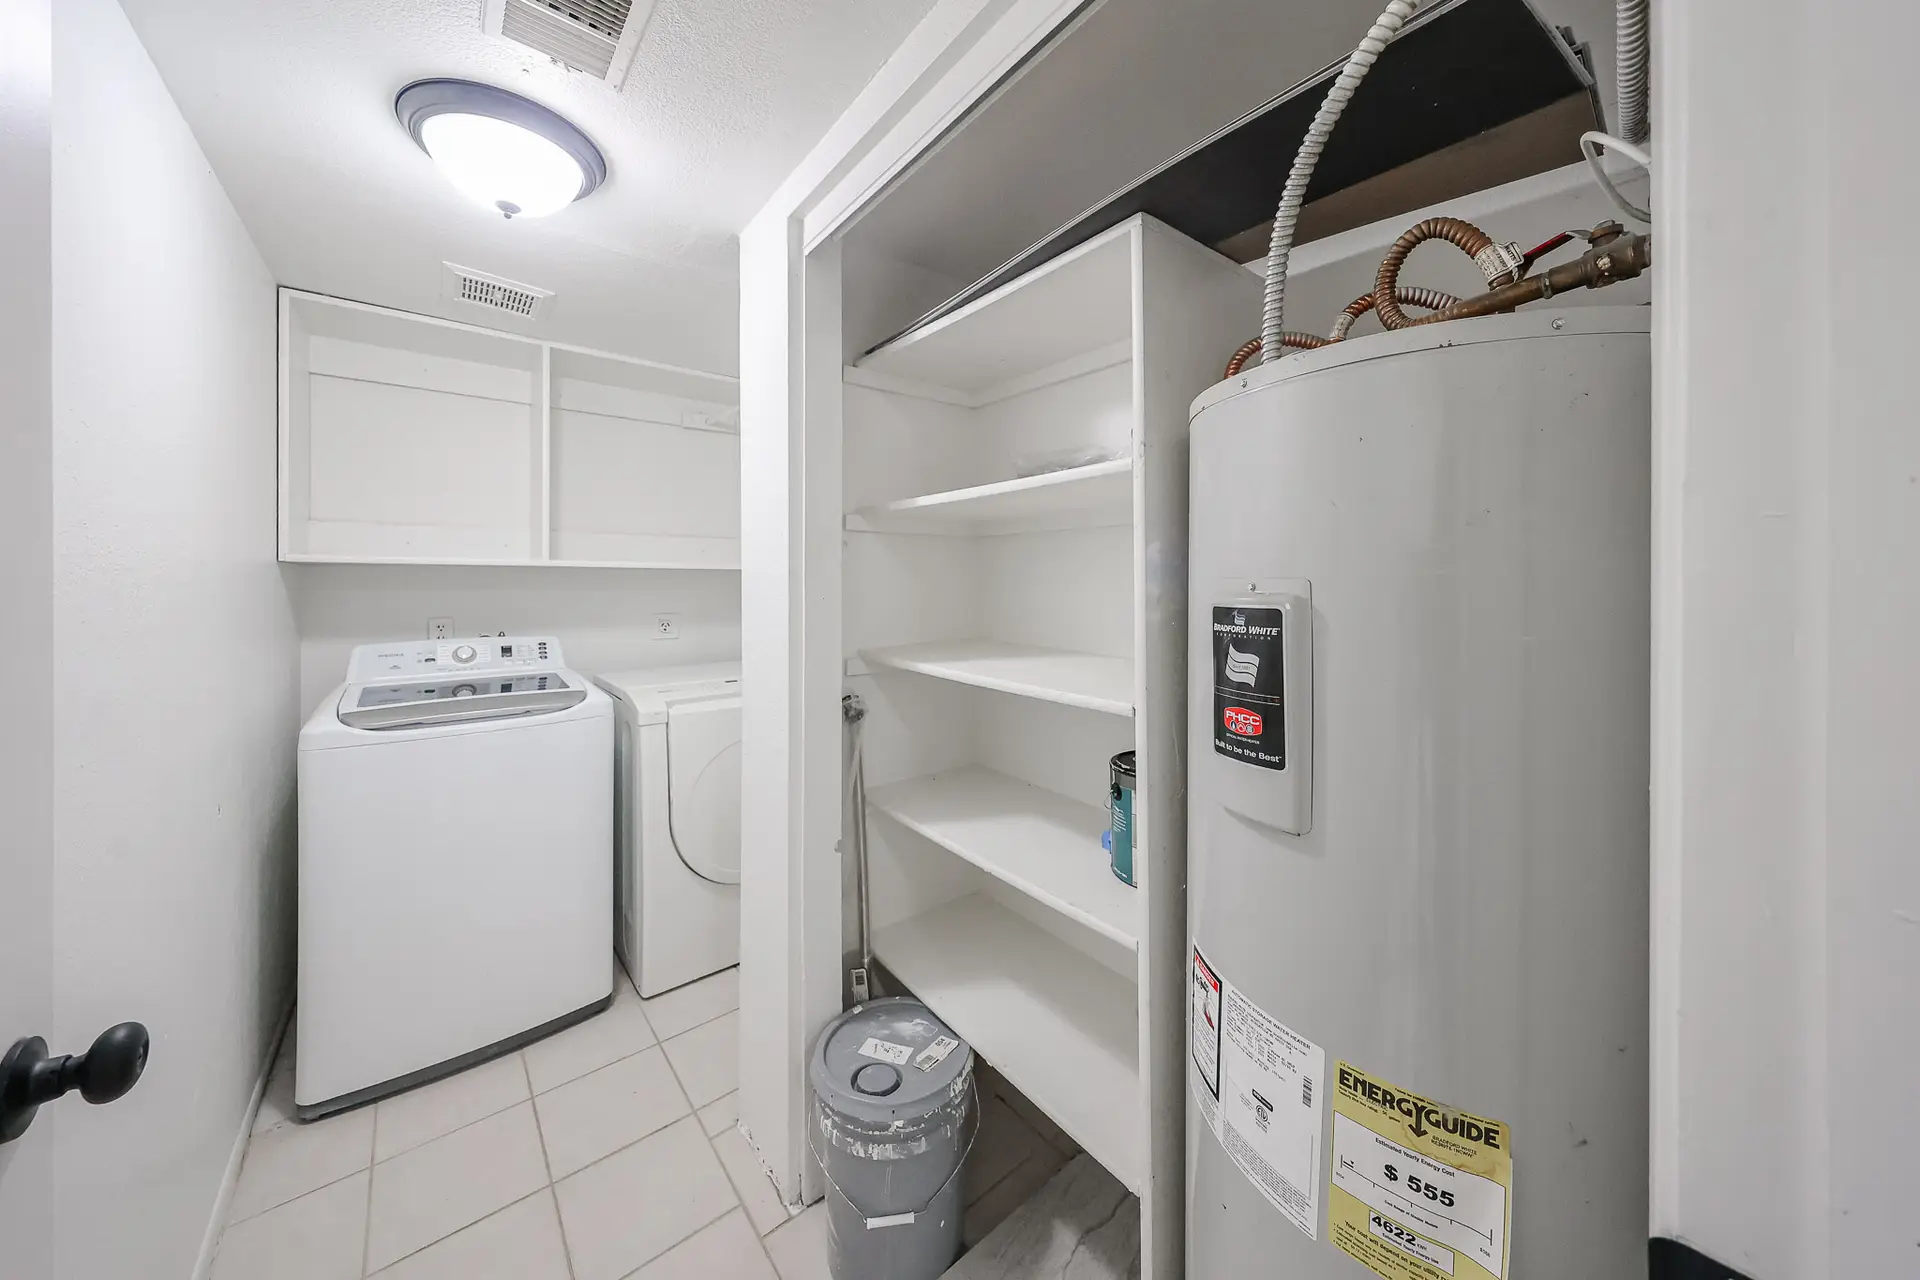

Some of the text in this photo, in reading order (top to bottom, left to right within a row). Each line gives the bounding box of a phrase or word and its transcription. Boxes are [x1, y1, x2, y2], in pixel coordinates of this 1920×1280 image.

[1214, 622, 1278, 636] BRADFORD WHITE
[1226, 710, 1260, 726] PHCC
[1216, 738, 1225, 749] Built
[1234, 746, 1242, 754] be
[1244, 749, 1256, 758] the
[1259, 753, 1280, 763] Best
[1375, 1137, 1455, 1177] Estimated Yearly Energy Cost
[1384, 1164, 1454, 1207] $ 555
[1372, 1216, 1416, 1247] 4622
[1345, 1220, 1356, 1231] Your
[1357, 1230, 1368, 1239] cost
[1369, 1237, 1378, 1246] will
[1380, 1244, 1400, 1258] depend
[1409, 1259, 1421, 1269] your
[1423, 1266, 1440, 1279] utility
